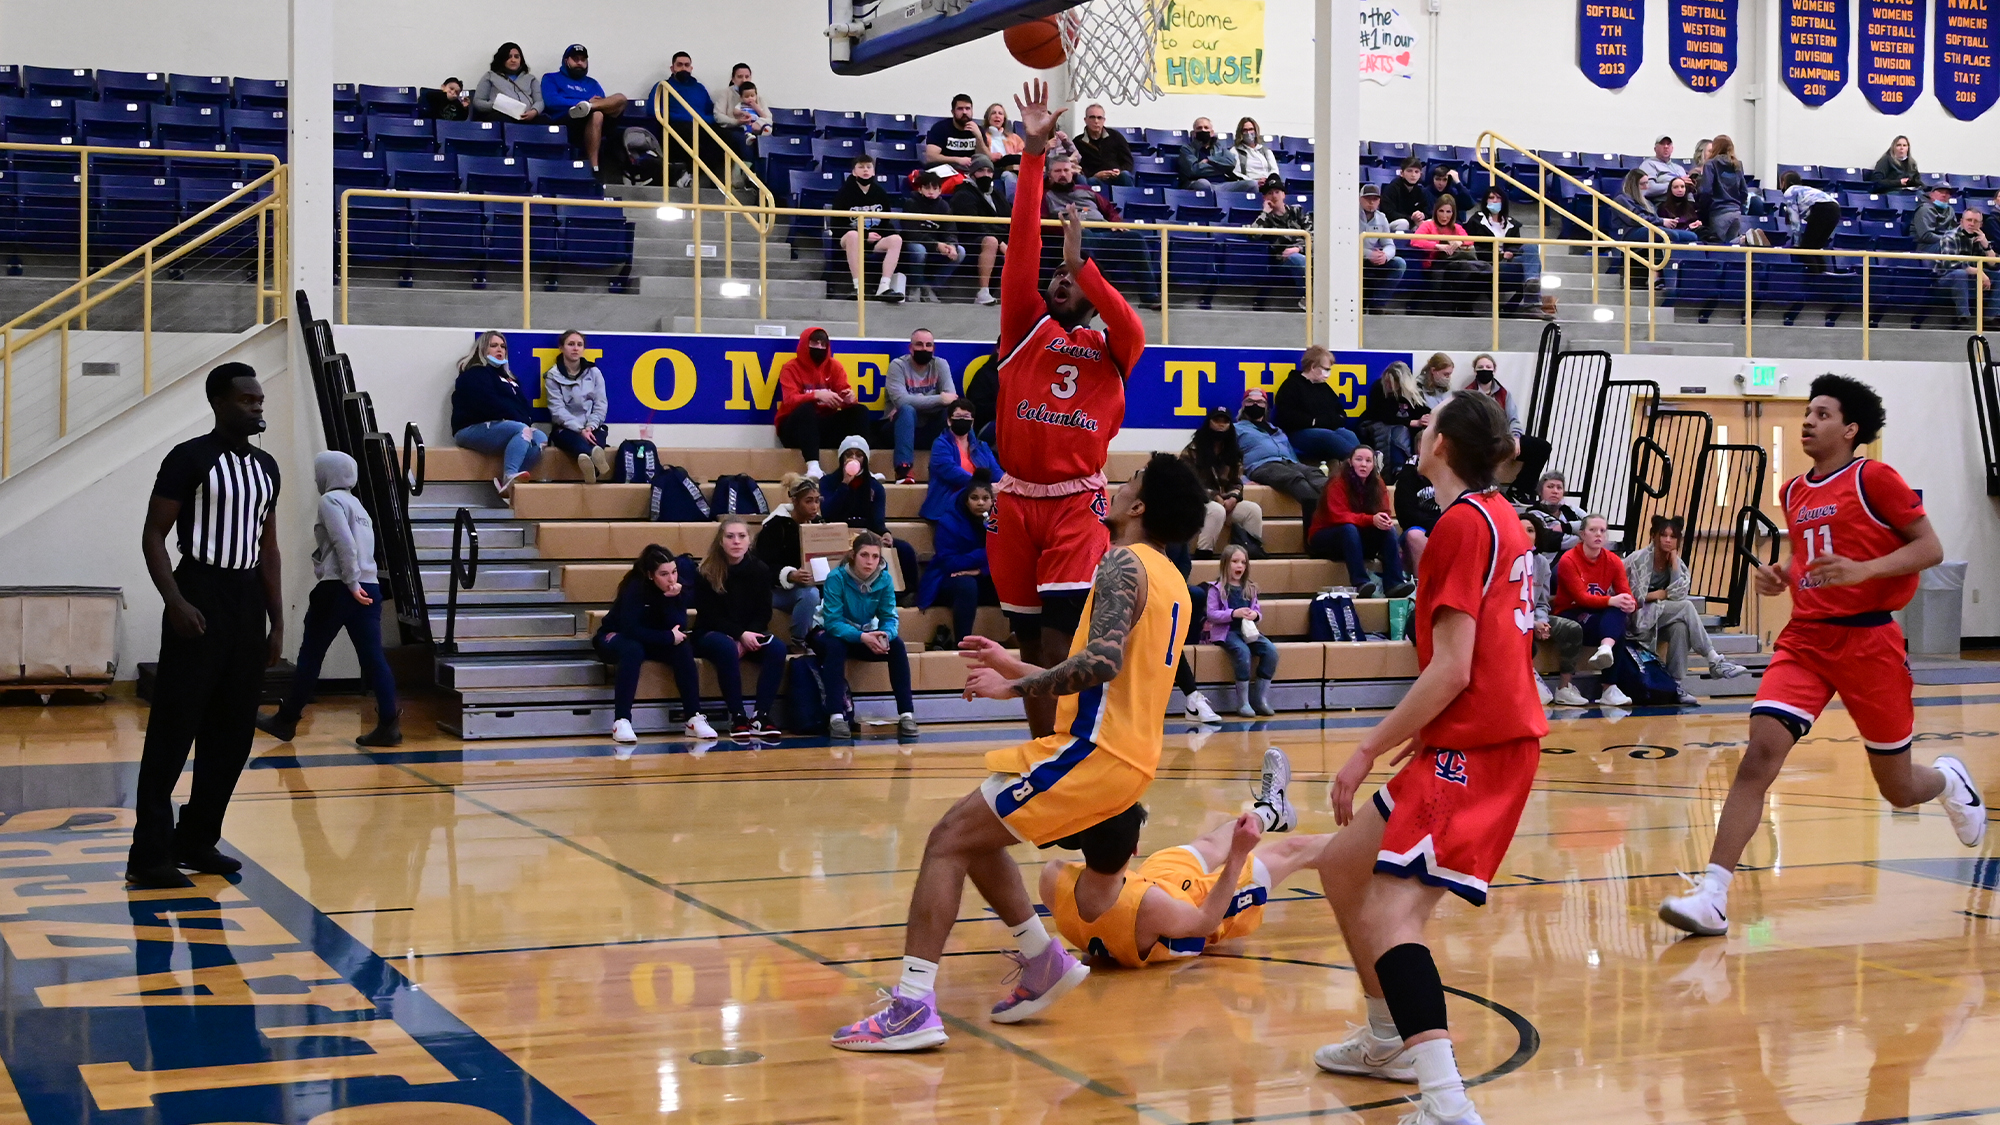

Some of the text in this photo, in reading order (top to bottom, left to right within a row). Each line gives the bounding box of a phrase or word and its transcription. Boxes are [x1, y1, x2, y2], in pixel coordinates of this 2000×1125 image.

[1368, 7, 1392, 28] the
[1586, 4, 1636, 20] SOFTBALL
[1681, 4, 1727, 20] SOFTBALL
[1872, 7, 1913, 21] WOMENS
[1682, 22, 1726, 38] WESTERN
[1791, 15, 1836, 30] SOFTBALL
[1948, 16, 1988, 29] WOMENS
[1600, 25, 1622, 37] 7TH
[1868, 23, 1916, 38] SOFTBALL
[1161, 30, 1219, 51] to our
[1360, 27, 1414, 51] #1 in our
[1791, 32, 1837, 47] WESTERN
[1945, 33, 1989, 48] SOFTBALL
[1596, 43, 1627, 56] STATE
[1686, 40, 1723, 54] DIVISION
[1870, 40, 1915, 54] WESTERN
[1680, 57, 1728, 72] CHAMPIONS
[1795, 50, 1833, 64] DIVISION
[1874, 56, 1911, 70] DIVISION
[1944, 52, 1991, 67] 5TH PLACE
[1166, 48, 1263, 87] HOUSE!
[1598, 63, 1625, 75] 2013
[1789, 66, 1840, 82] CHAMPIONS
[1691, 75, 1717, 87] 2014
[1867, 73, 1916, 87] CHAMPIONS
[1954, 71, 1981, 85] STATE
[1803, 84, 1826, 96] 2015
[1881, 91, 1903, 103] 2016
[1955, 90, 1976, 103] 2016
[1045, 337, 1102, 362] Lower
[1050, 363, 1079, 400] 3
[1753, 366, 1776, 386] EXIT
[1016, 399, 1098, 432] Columbia
[1795, 503, 1838, 524] Lower
[1803, 524, 1834, 566] 11
[1165, 601, 1180, 668] 1
[1012, 780, 1034, 802] B
[1237, 893, 1253, 909] B
